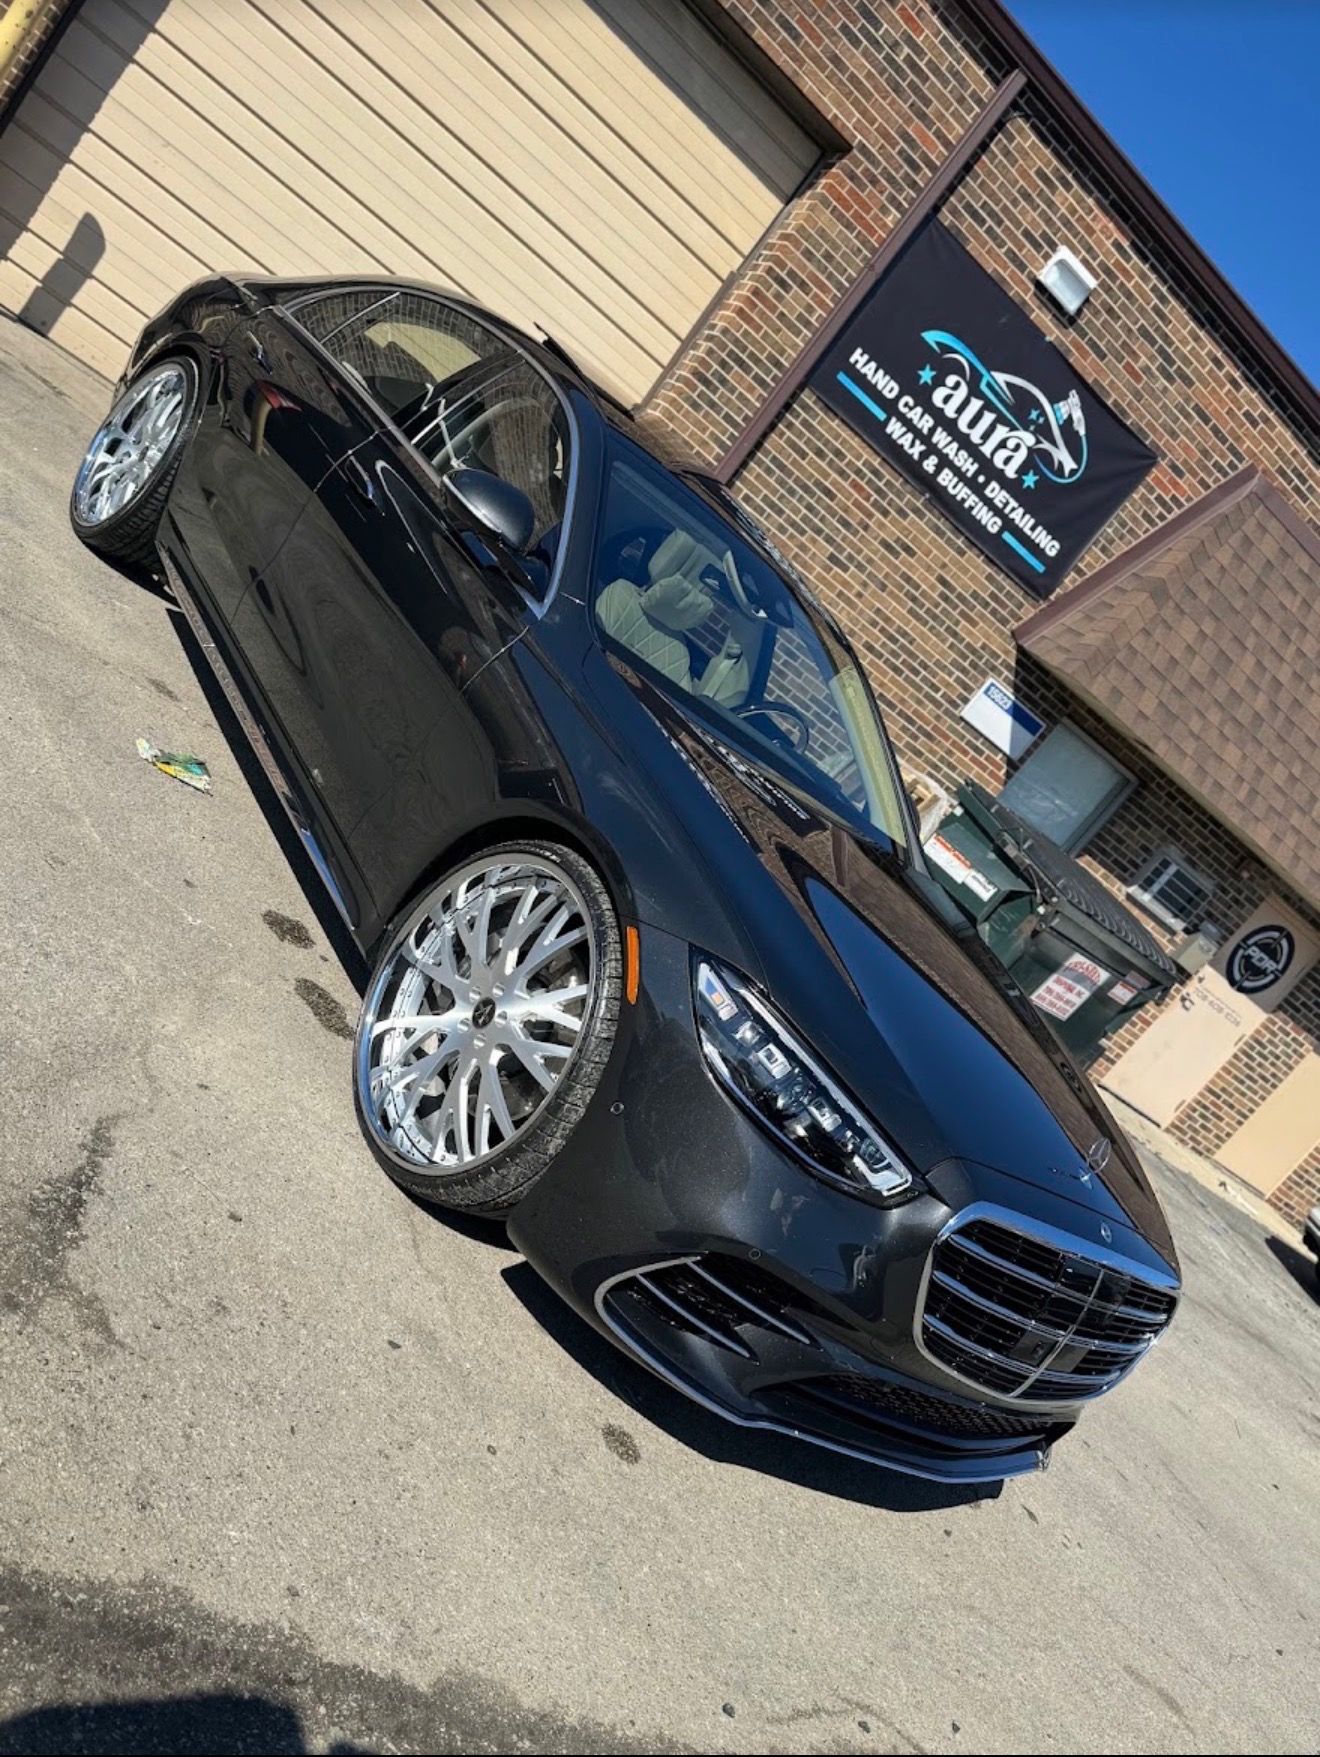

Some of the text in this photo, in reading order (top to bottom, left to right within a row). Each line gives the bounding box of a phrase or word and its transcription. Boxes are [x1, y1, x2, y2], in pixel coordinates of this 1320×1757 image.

[849, 348, 1060, 556] HAND CAR WASH DETAILING
[886, 417, 1003, 534] WAX & BUFFING
[932, 375, 1036, 478] aura
[1244, 945, 1278, 974] PDR
